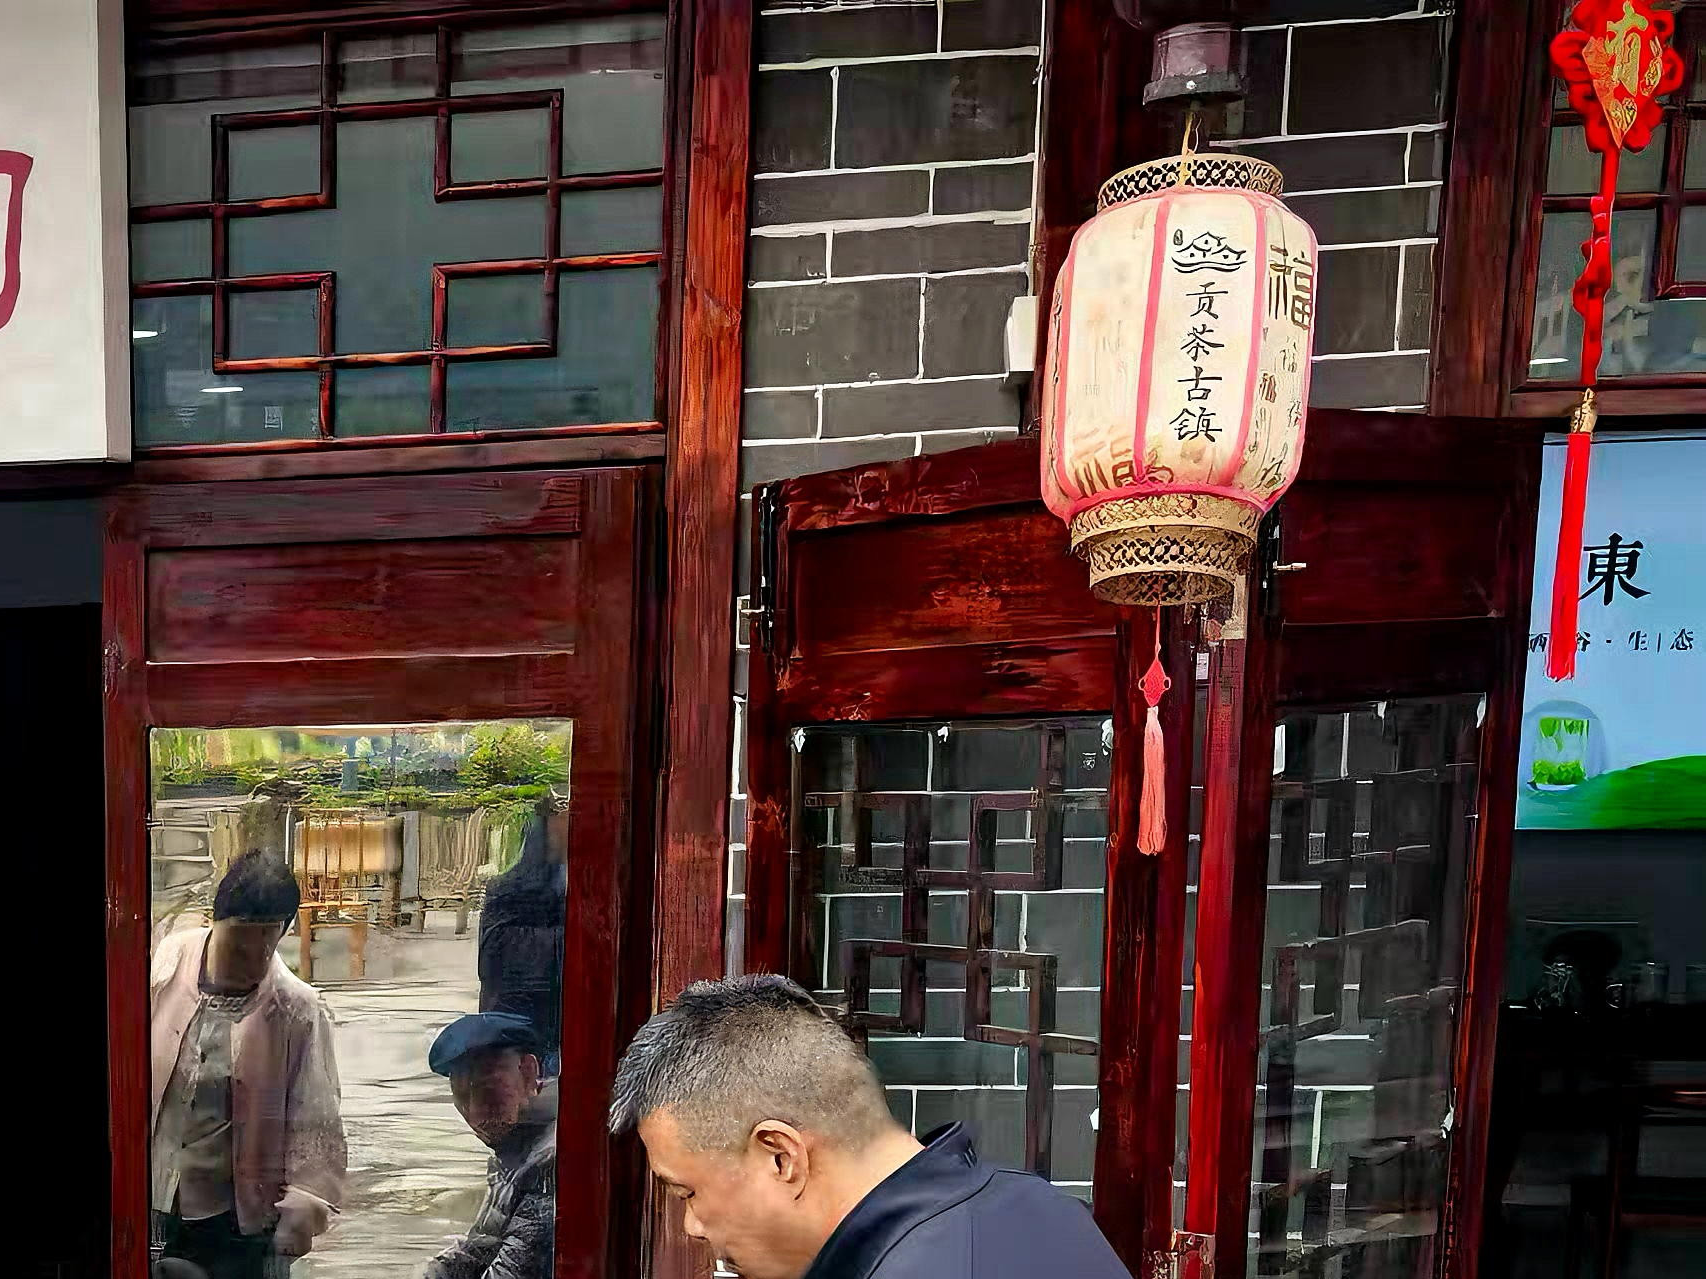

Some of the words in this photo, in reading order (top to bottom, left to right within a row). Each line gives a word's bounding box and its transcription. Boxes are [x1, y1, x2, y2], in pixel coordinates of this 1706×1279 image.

[1168, 282, 1229, 443] 贡茶古镇
[1578, 532, 1652, 606] 東
